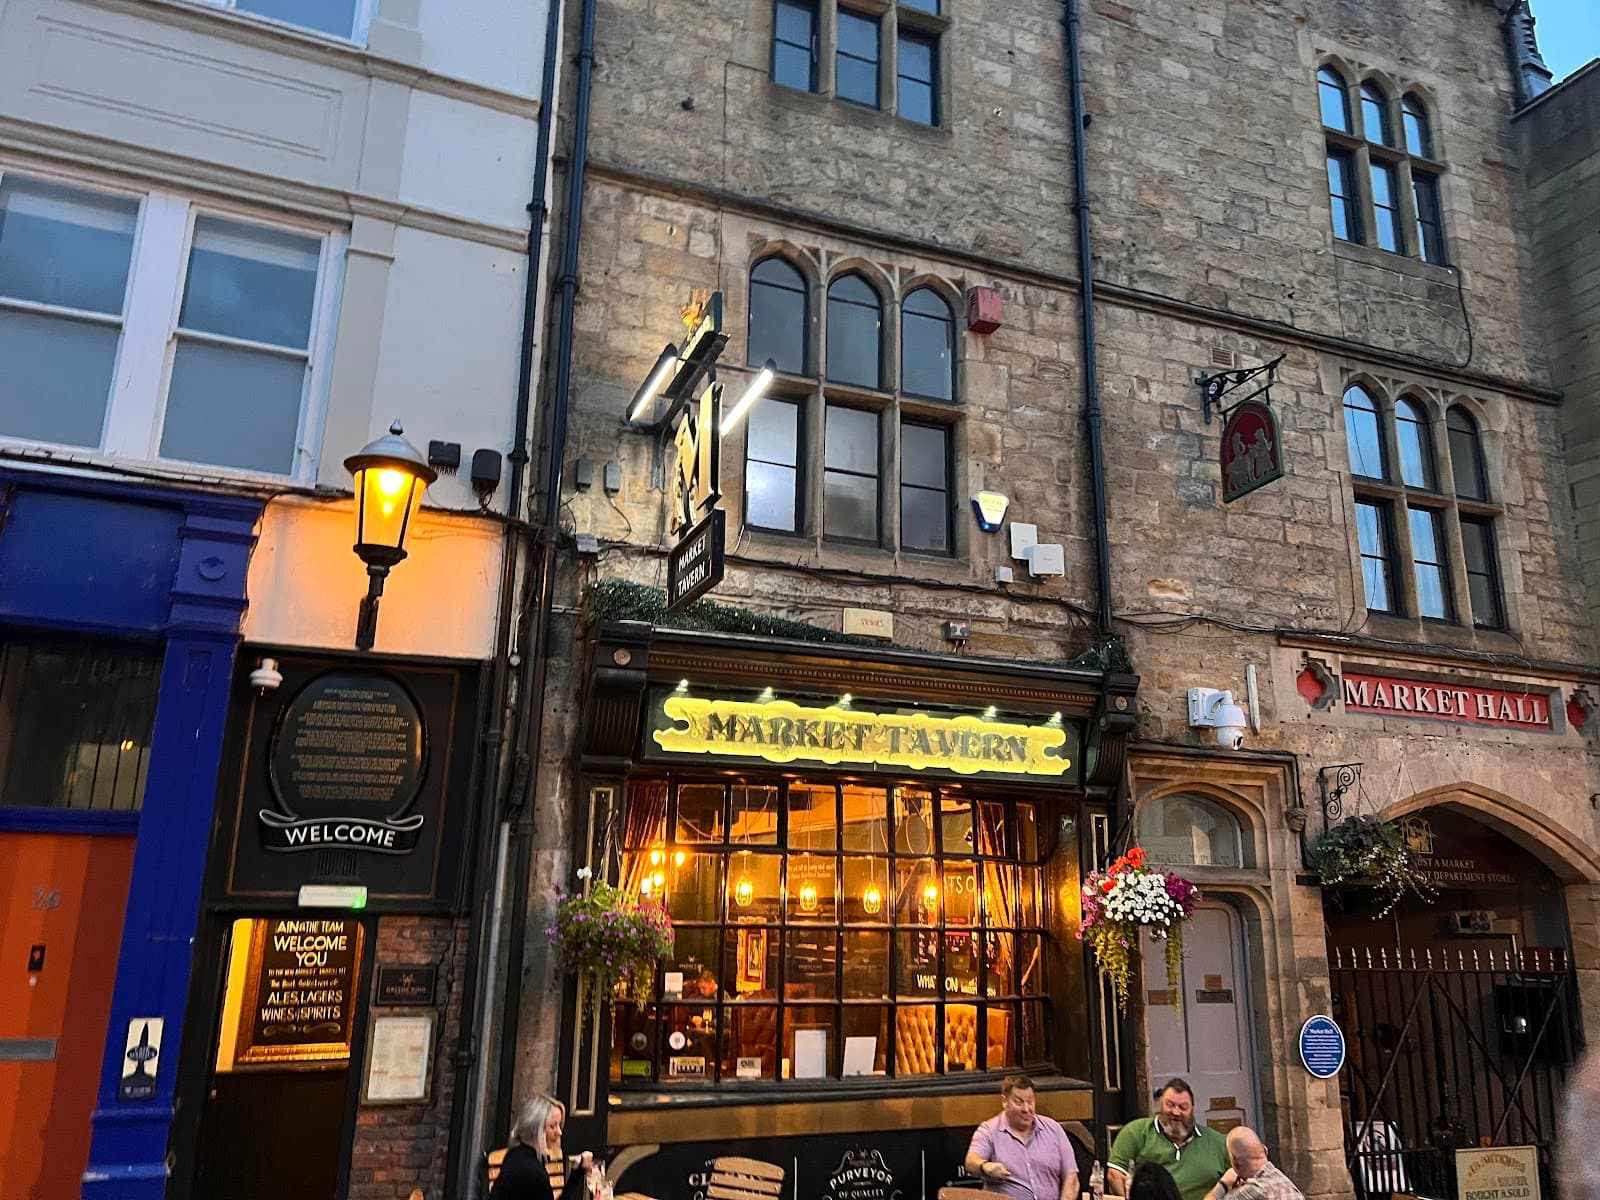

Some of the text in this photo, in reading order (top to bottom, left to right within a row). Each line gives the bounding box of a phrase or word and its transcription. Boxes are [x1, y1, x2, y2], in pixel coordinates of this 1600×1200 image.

[678, 534, 707, 573] MARKET
[677, 561, 706, 597] TAVERN
[1343, 678, 1549, 724] MARKET HALL
[705, 711, 1029, 763] MARKET TAVERN
[284, 824, 396, 847] WELCOME
[1441, 860, 1475, 870] MARKET
[1433, 871, 1487, 881] DEPARTMENT
[321, 920, 344, 933] TEAM
[273, 935, 348, 952] WELCOME
[295, 951, 328, 968] YOU
[945, 977, 958, 993] ON
[301, 989, 343, 1004] LAGERS
[261, 1006, 295, 1022] WINES
[300, 1005, 341, 1021] SPIRITS
[829, 1167, 893, 1191] PURVEYOR
[838, 1188, 884, 1200] OF QUALITY
[1466, 1189, 1500, 1200] BOUGHT
[1507, 1188, 1530, 1198] SOLD
